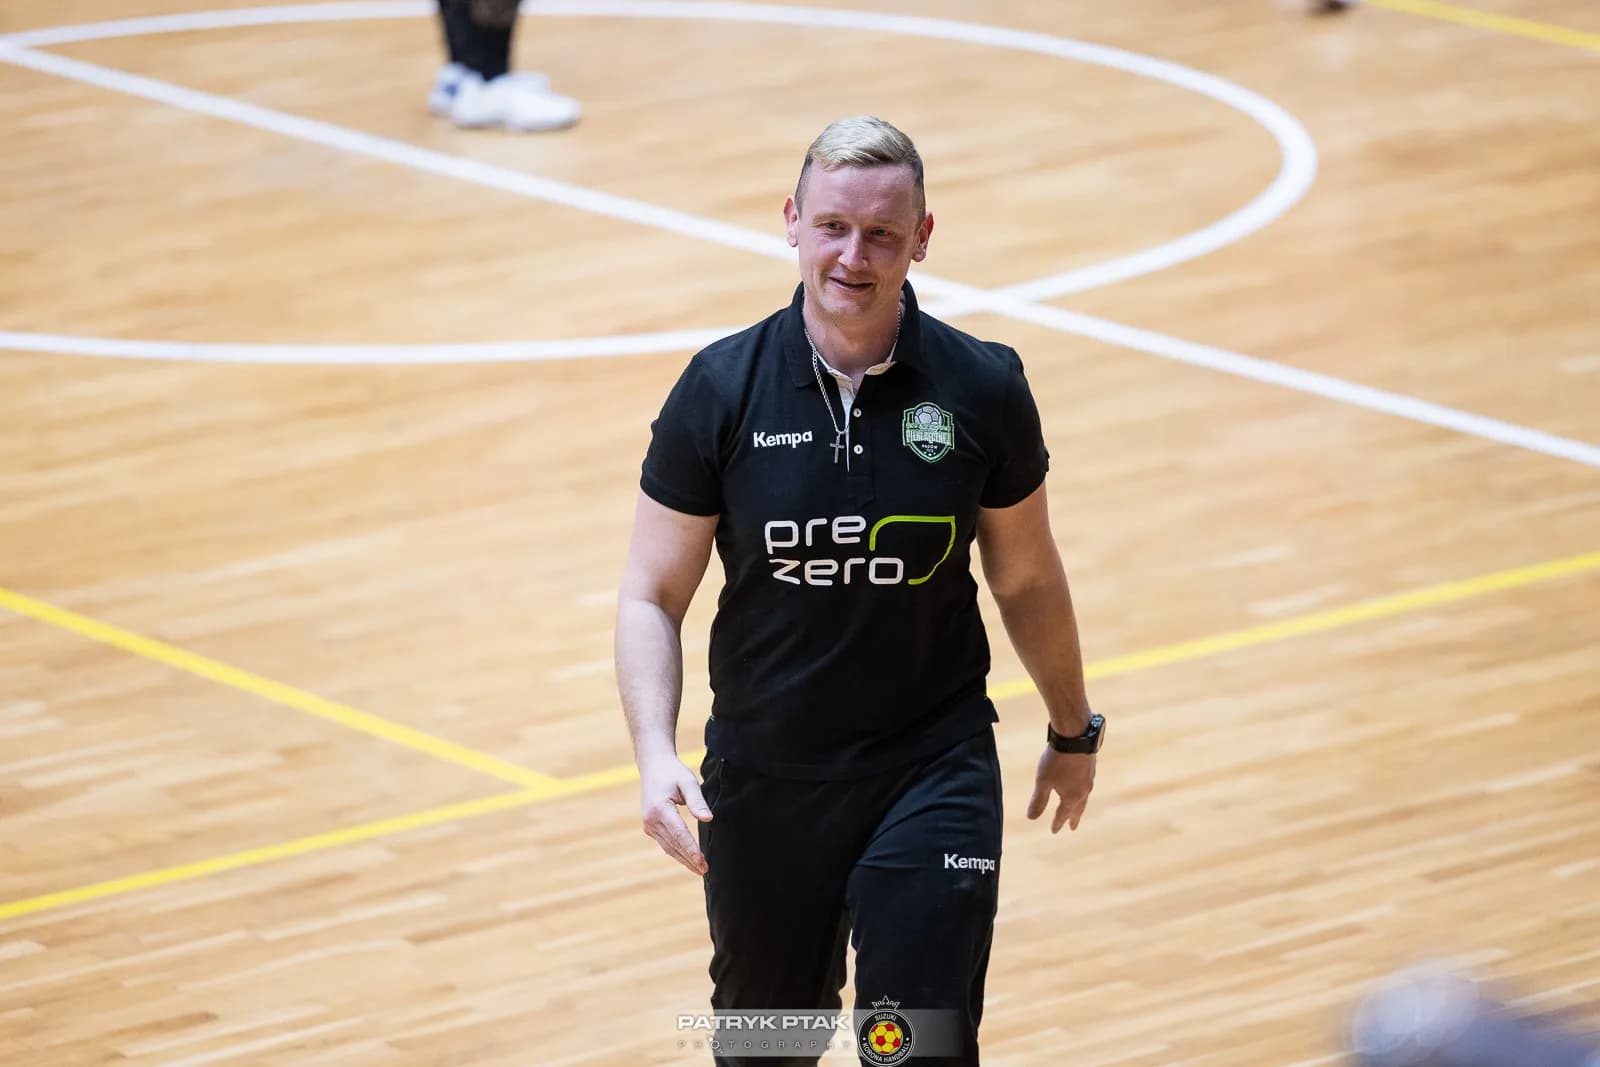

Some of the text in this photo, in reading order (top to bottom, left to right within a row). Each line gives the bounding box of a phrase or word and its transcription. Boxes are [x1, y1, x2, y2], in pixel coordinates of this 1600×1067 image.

[753, 430, 813, 449] Kempa
[764, 515, 867, 555] pre
[768, 557, 904, 586] zero
[943, 853, 996, 875] Kempa
